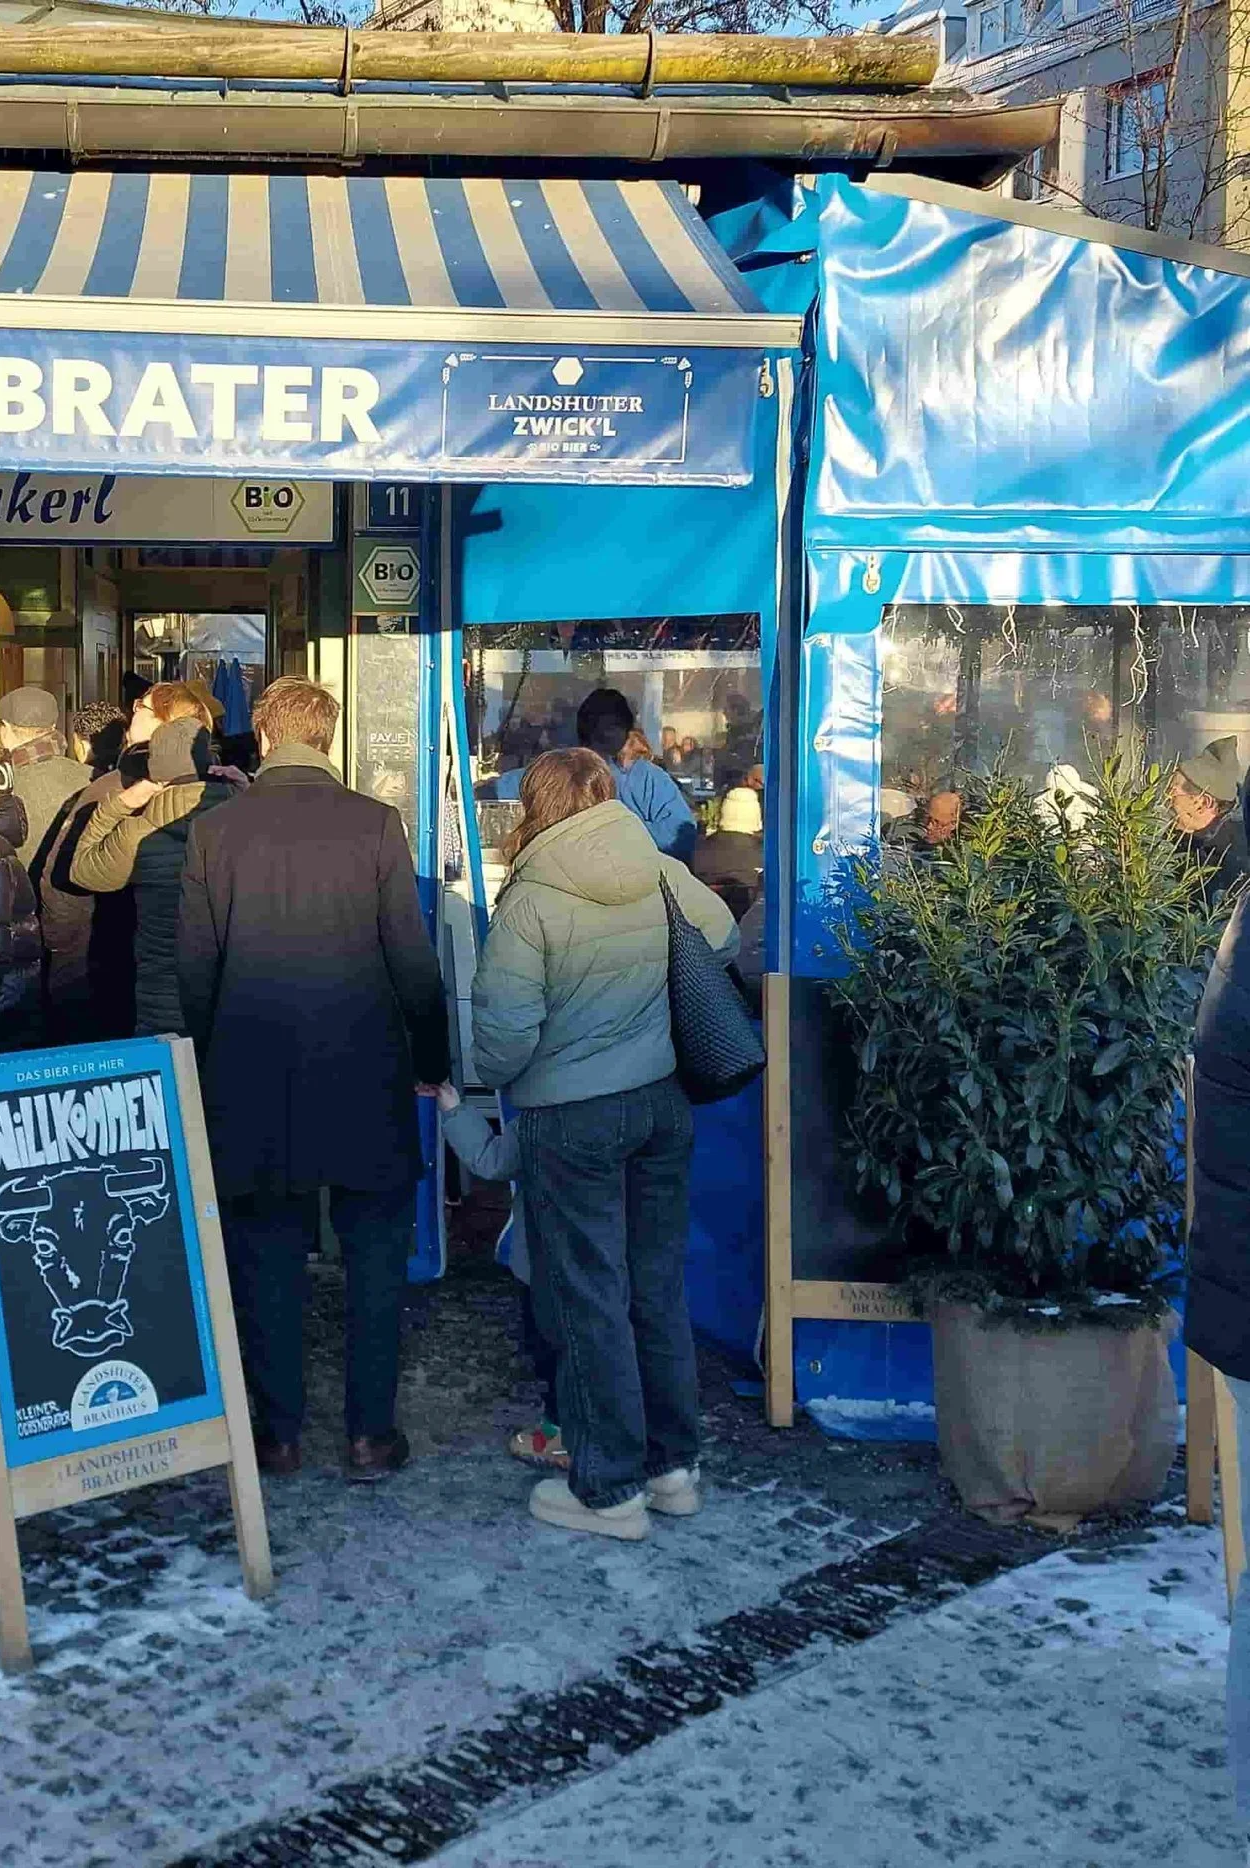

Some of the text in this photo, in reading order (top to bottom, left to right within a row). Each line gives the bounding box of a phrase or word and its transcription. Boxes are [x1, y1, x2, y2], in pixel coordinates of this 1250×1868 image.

[488, 394, 643, 414] LANDSHUTER
[512, 416, 617, 437] ZWICK'L
[385, 486, 411, 516] 11
[16, 1071, 41, 1083] DAS
[44, 1066, 69, 1079] BIER
[99, 1058, 125, 1071] HIER
[77, 1367, 148, 1408] LANDSHUTER
[83, 1401, 148, 1425] BRAUHAUS
[65, 1437, 178, 1477] LANDSHUTER
[81, 1459, 170, 1491] BRAUHAUS
